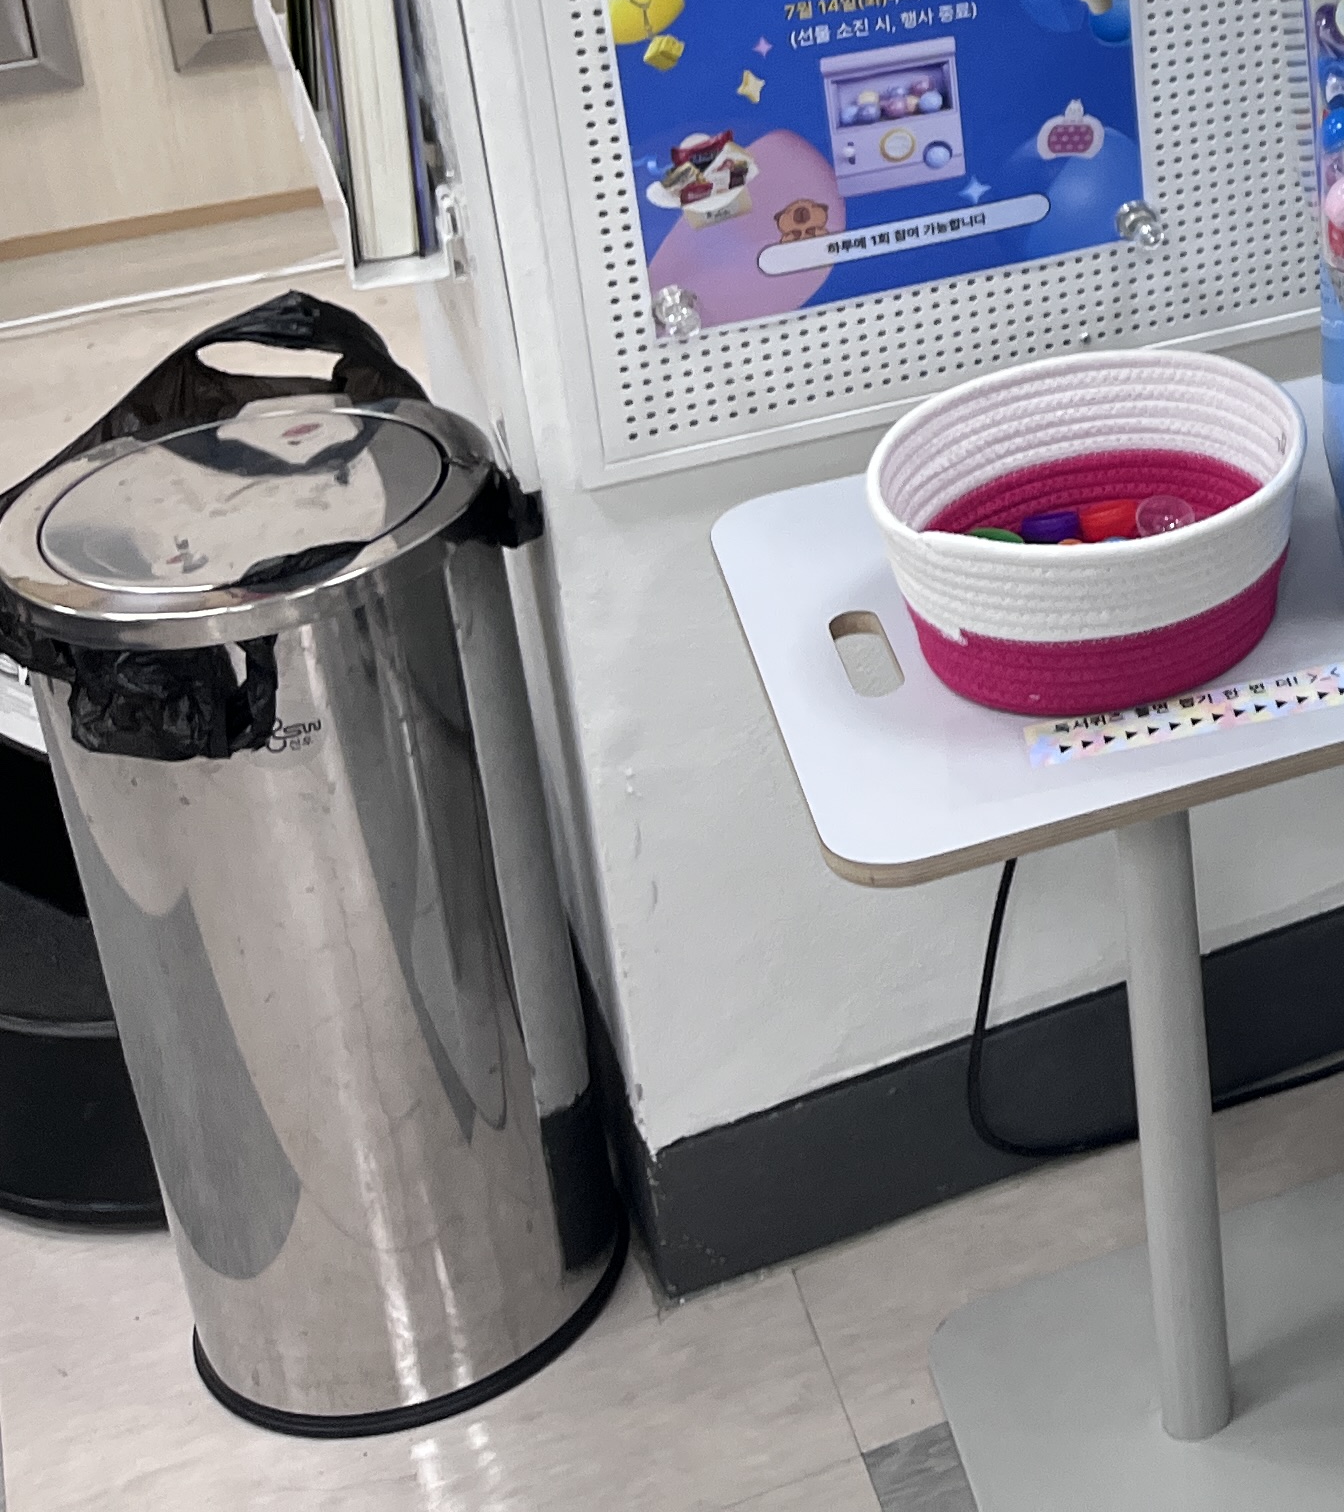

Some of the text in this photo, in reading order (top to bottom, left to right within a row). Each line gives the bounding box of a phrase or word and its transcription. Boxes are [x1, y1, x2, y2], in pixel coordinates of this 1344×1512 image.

[783, 0, 814, 22] 7월
[789, 22, 832, 50] (선물
[835, 16, 871, 42] 소진
[900, 7, 935, 32] 행사
[938, 1, 978, 28] 종료)
[922, 211, 987, 240] 가능합니다
[1223, 688, 1239, 701] 한
[1248, 682, 1267, 695] 번
